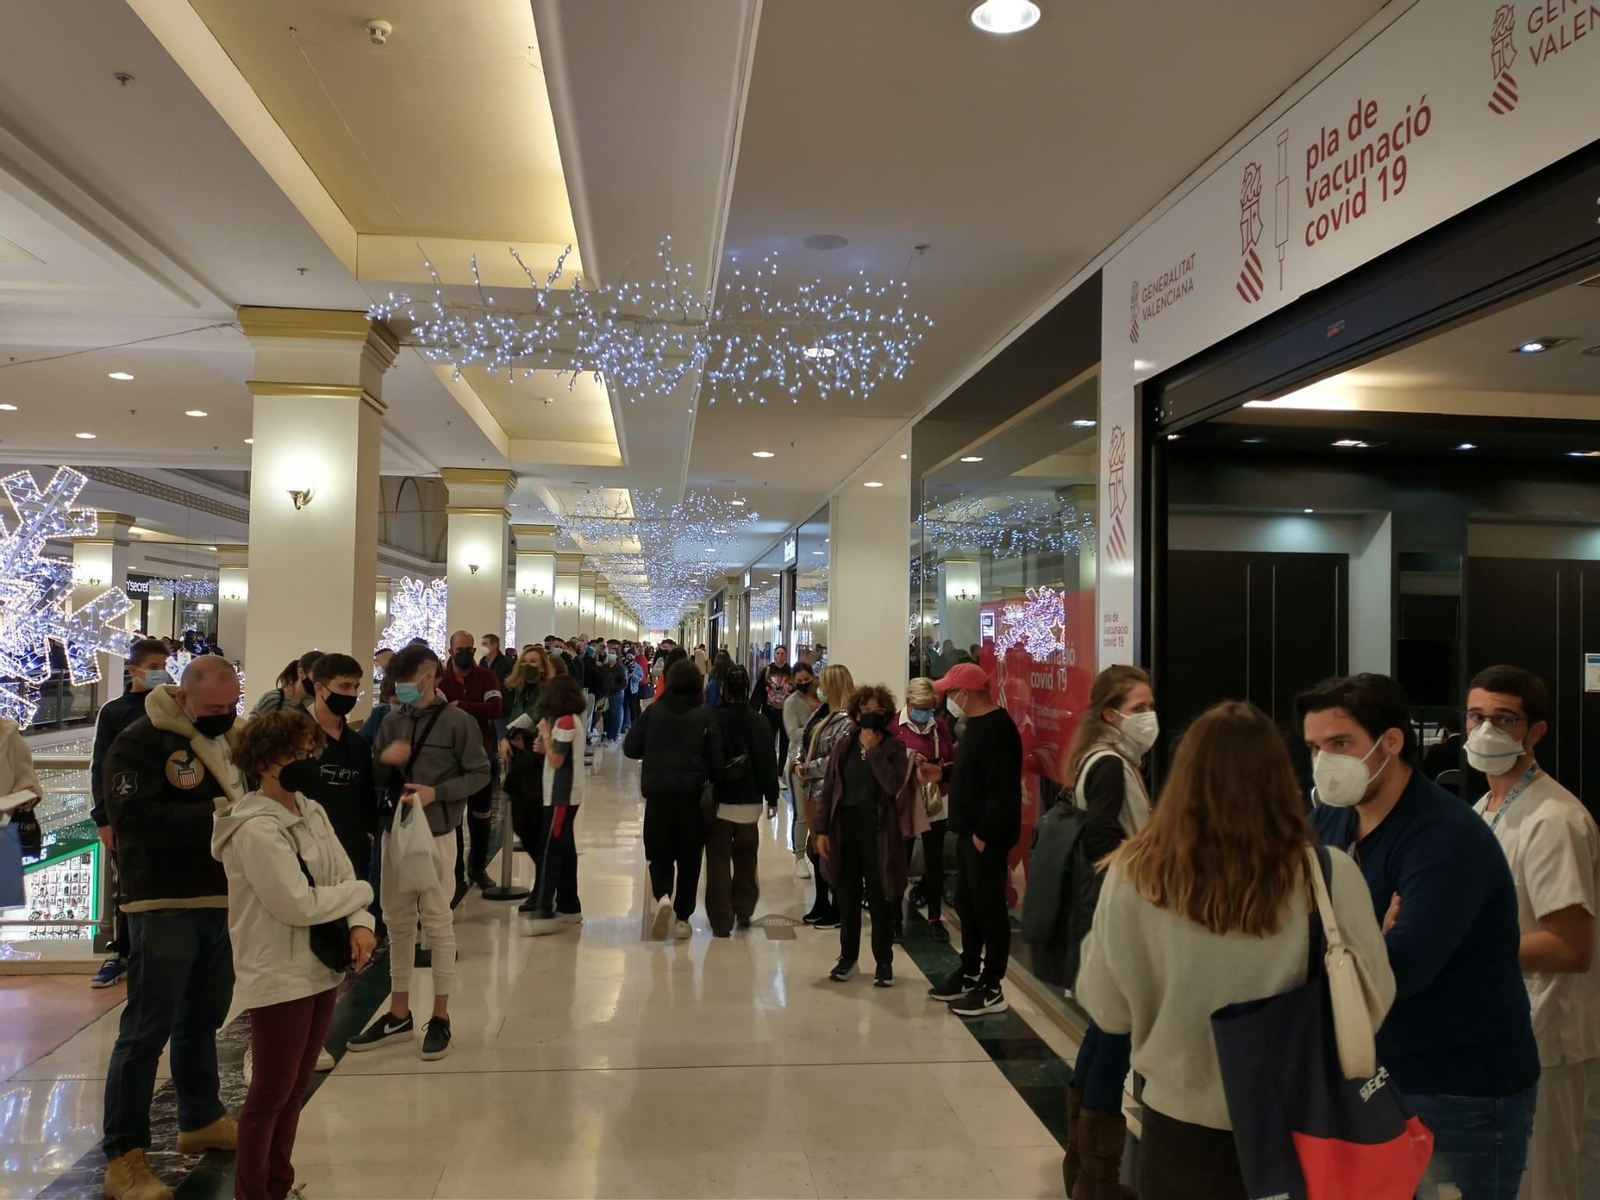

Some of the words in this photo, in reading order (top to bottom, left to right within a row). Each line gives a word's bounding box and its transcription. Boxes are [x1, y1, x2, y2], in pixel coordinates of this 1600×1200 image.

[1305, 93, 1431, 209] vacunació
[1306, 126, 1340, 182] pla
[1348, 98, 1378, 141] de
[1305, 176, 1367, 247] covid
[1377, 155, 1407, 203] 19
[1141, 252, 1196, 303] GENERALITAT
[1142, 277, 1194, 322] VALENCIANA
[1118, 635, 1125, 648] 19
[1030, 666, 1054, 690] covid
[1056, 667, 1068, 692] 19
